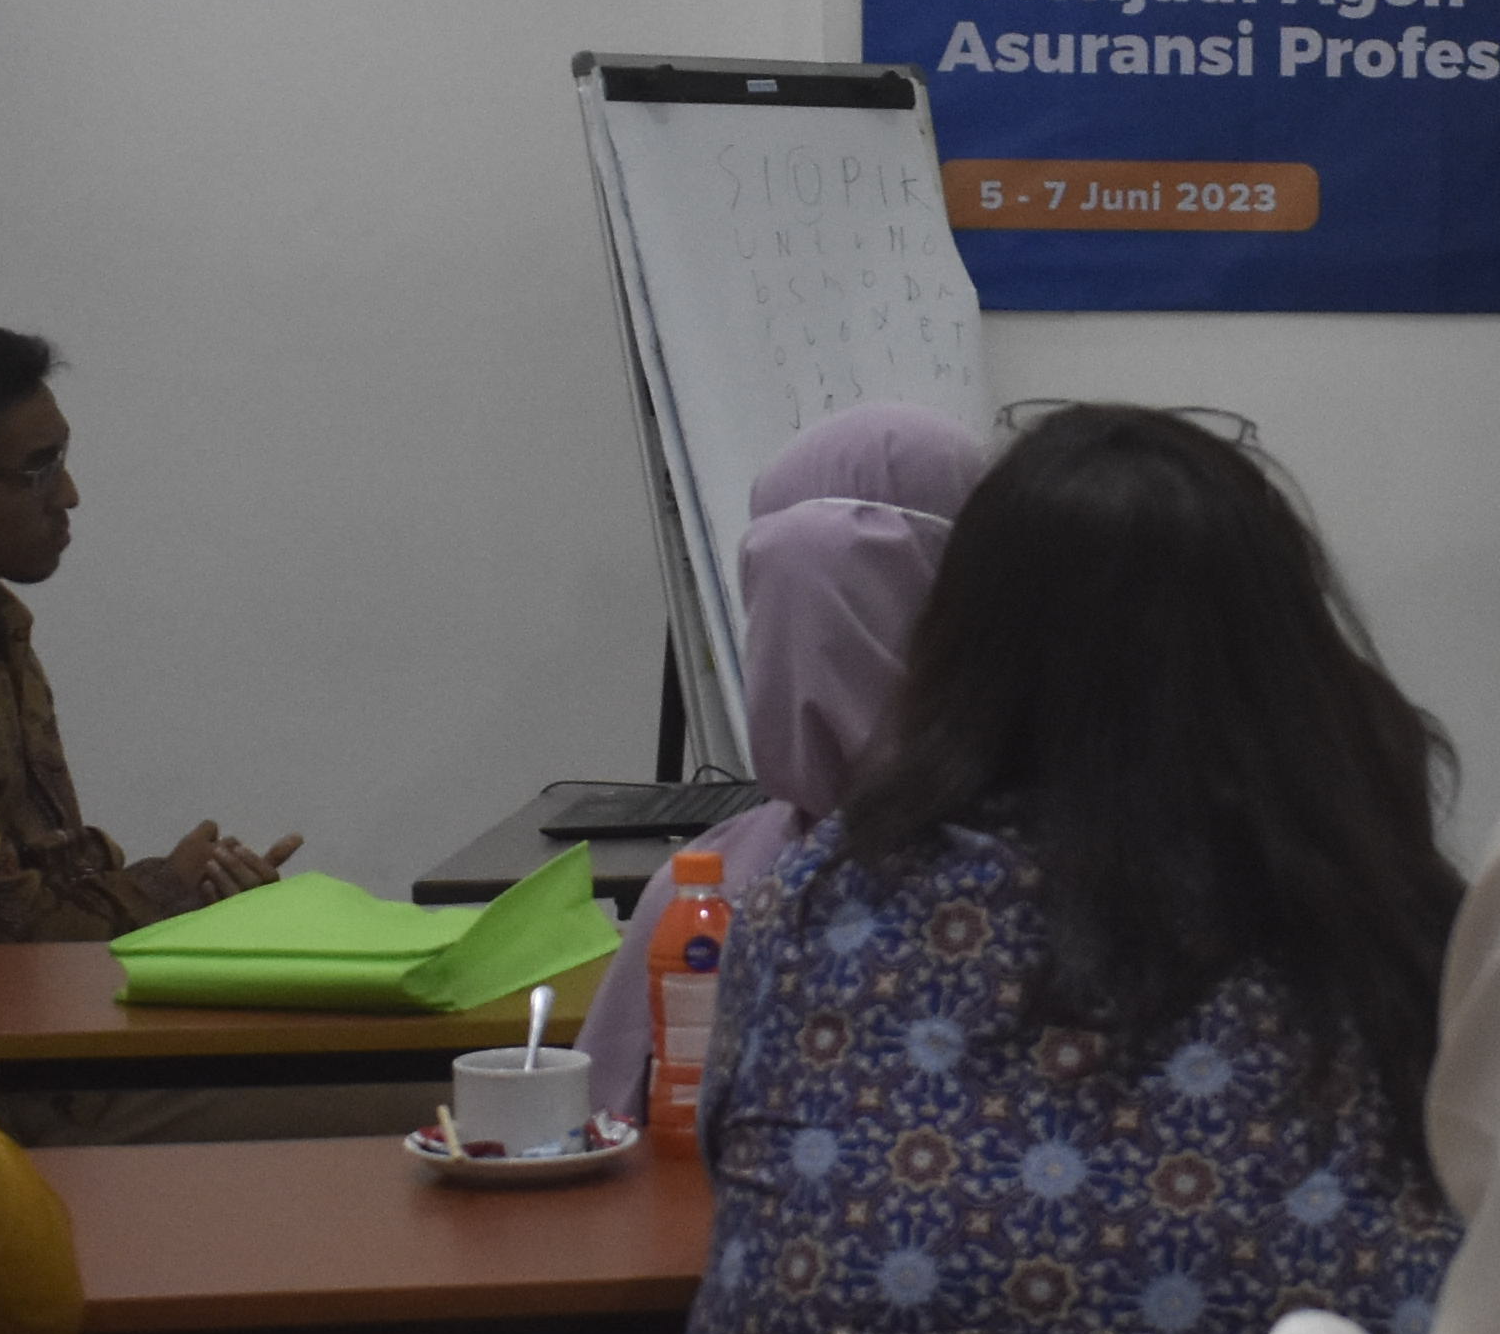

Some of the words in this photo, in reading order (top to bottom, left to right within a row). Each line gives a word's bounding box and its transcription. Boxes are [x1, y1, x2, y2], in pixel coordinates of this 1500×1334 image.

[937, 19, 1253, 76] Asuransi
[980, 180, 1004, 210] 5
[1043, 180, 1067, 210] 7
[1080, 181, 1161, 211] Juni
[1177, 182, 1277, 213] 2023
